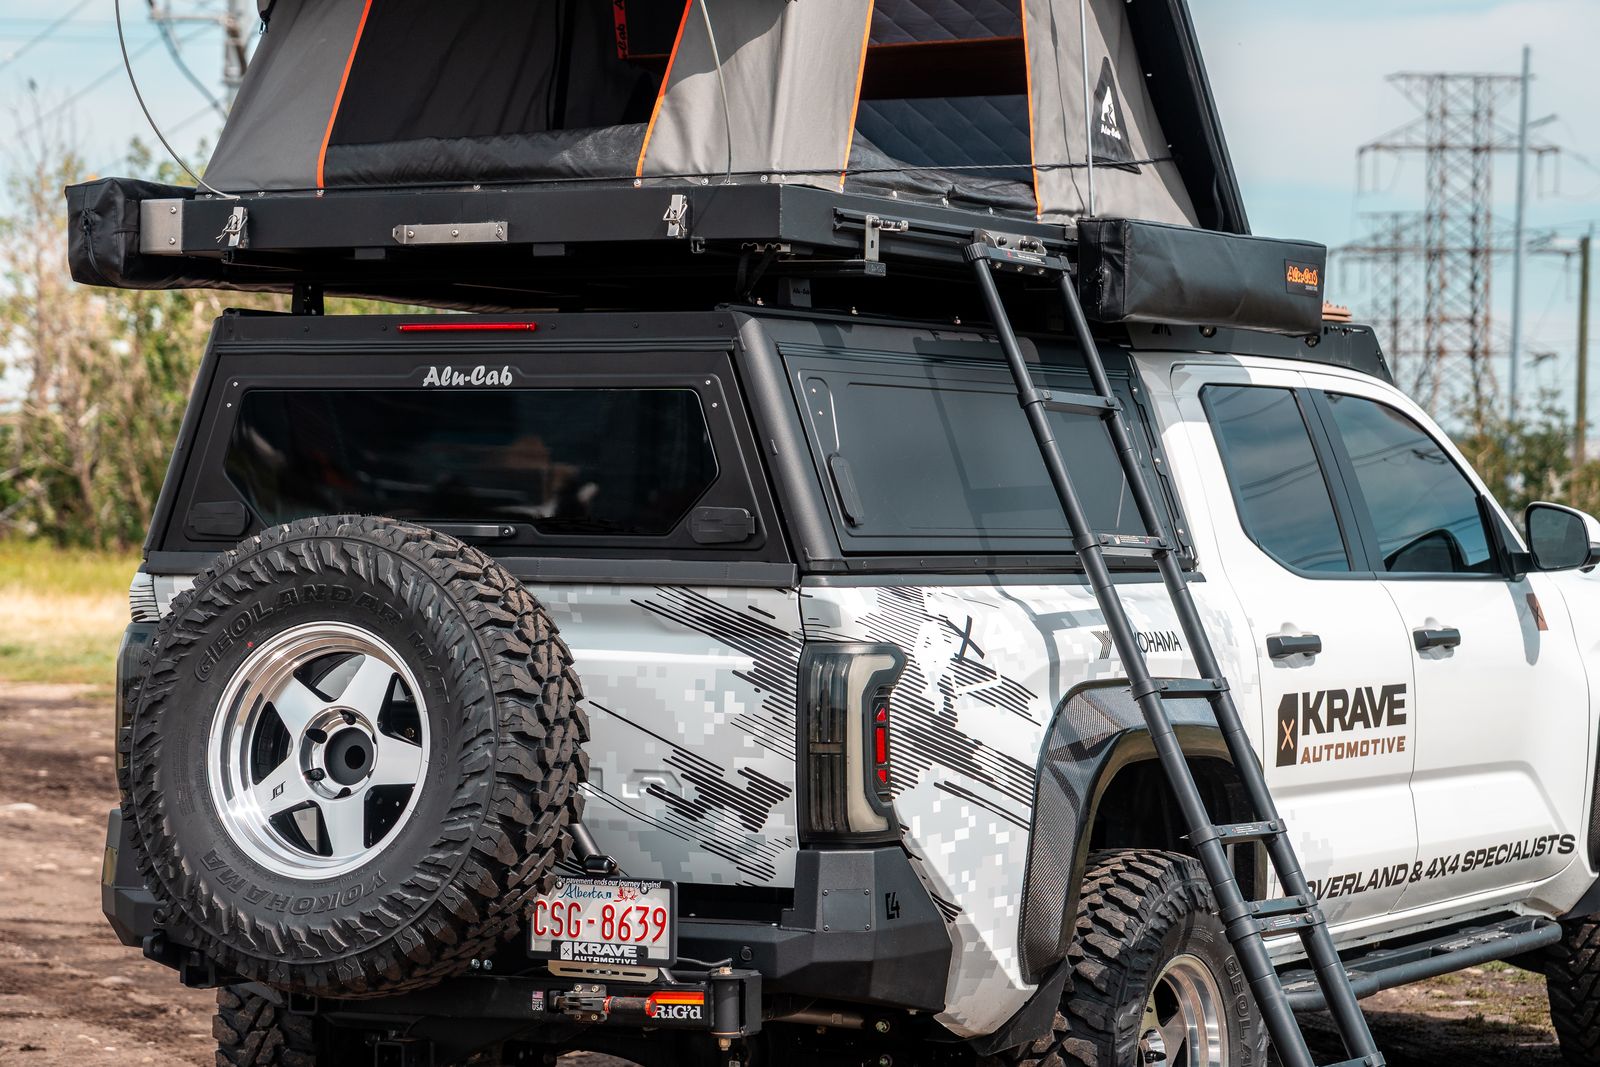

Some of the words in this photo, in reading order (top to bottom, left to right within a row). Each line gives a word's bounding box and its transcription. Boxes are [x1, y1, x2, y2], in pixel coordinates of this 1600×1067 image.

[422, 365, 513, 387] Alu-Cab
[194, 583, 403, 683] GEOLANDAR
[1132, 630, 1183, 653] OHAMA
[1301, 683, 1407, 736] KRAVE
[1300, 735, 1406, 765] AUTOMOTIVE
[1307, 863, 1409, 901] OVERLAND
[1408, 860, 1423, 883] &
[1424, 853, 1460, 879] 4X4
[1460, 833, 1576, 873] SPECIALISTS
[200, 848, 388, 916] YOKOHAMA
[558, 883, 605, 899] Alberta
[566, 877, 593, 886] pavement
[593, 878, 608, 886] ends
[618, 879, 641, 888] journey
[641, 880, 662, 889] begins!
[533, 899, 668, 943] CSG-8639
[573, 941, 638, 958] KRAVE
[574, 955, 638, 965] AUTOMOTIVE
[652, 1005, 703, 1020] RiG'd
[1224, 954, 1252, 1067] GEOLA
